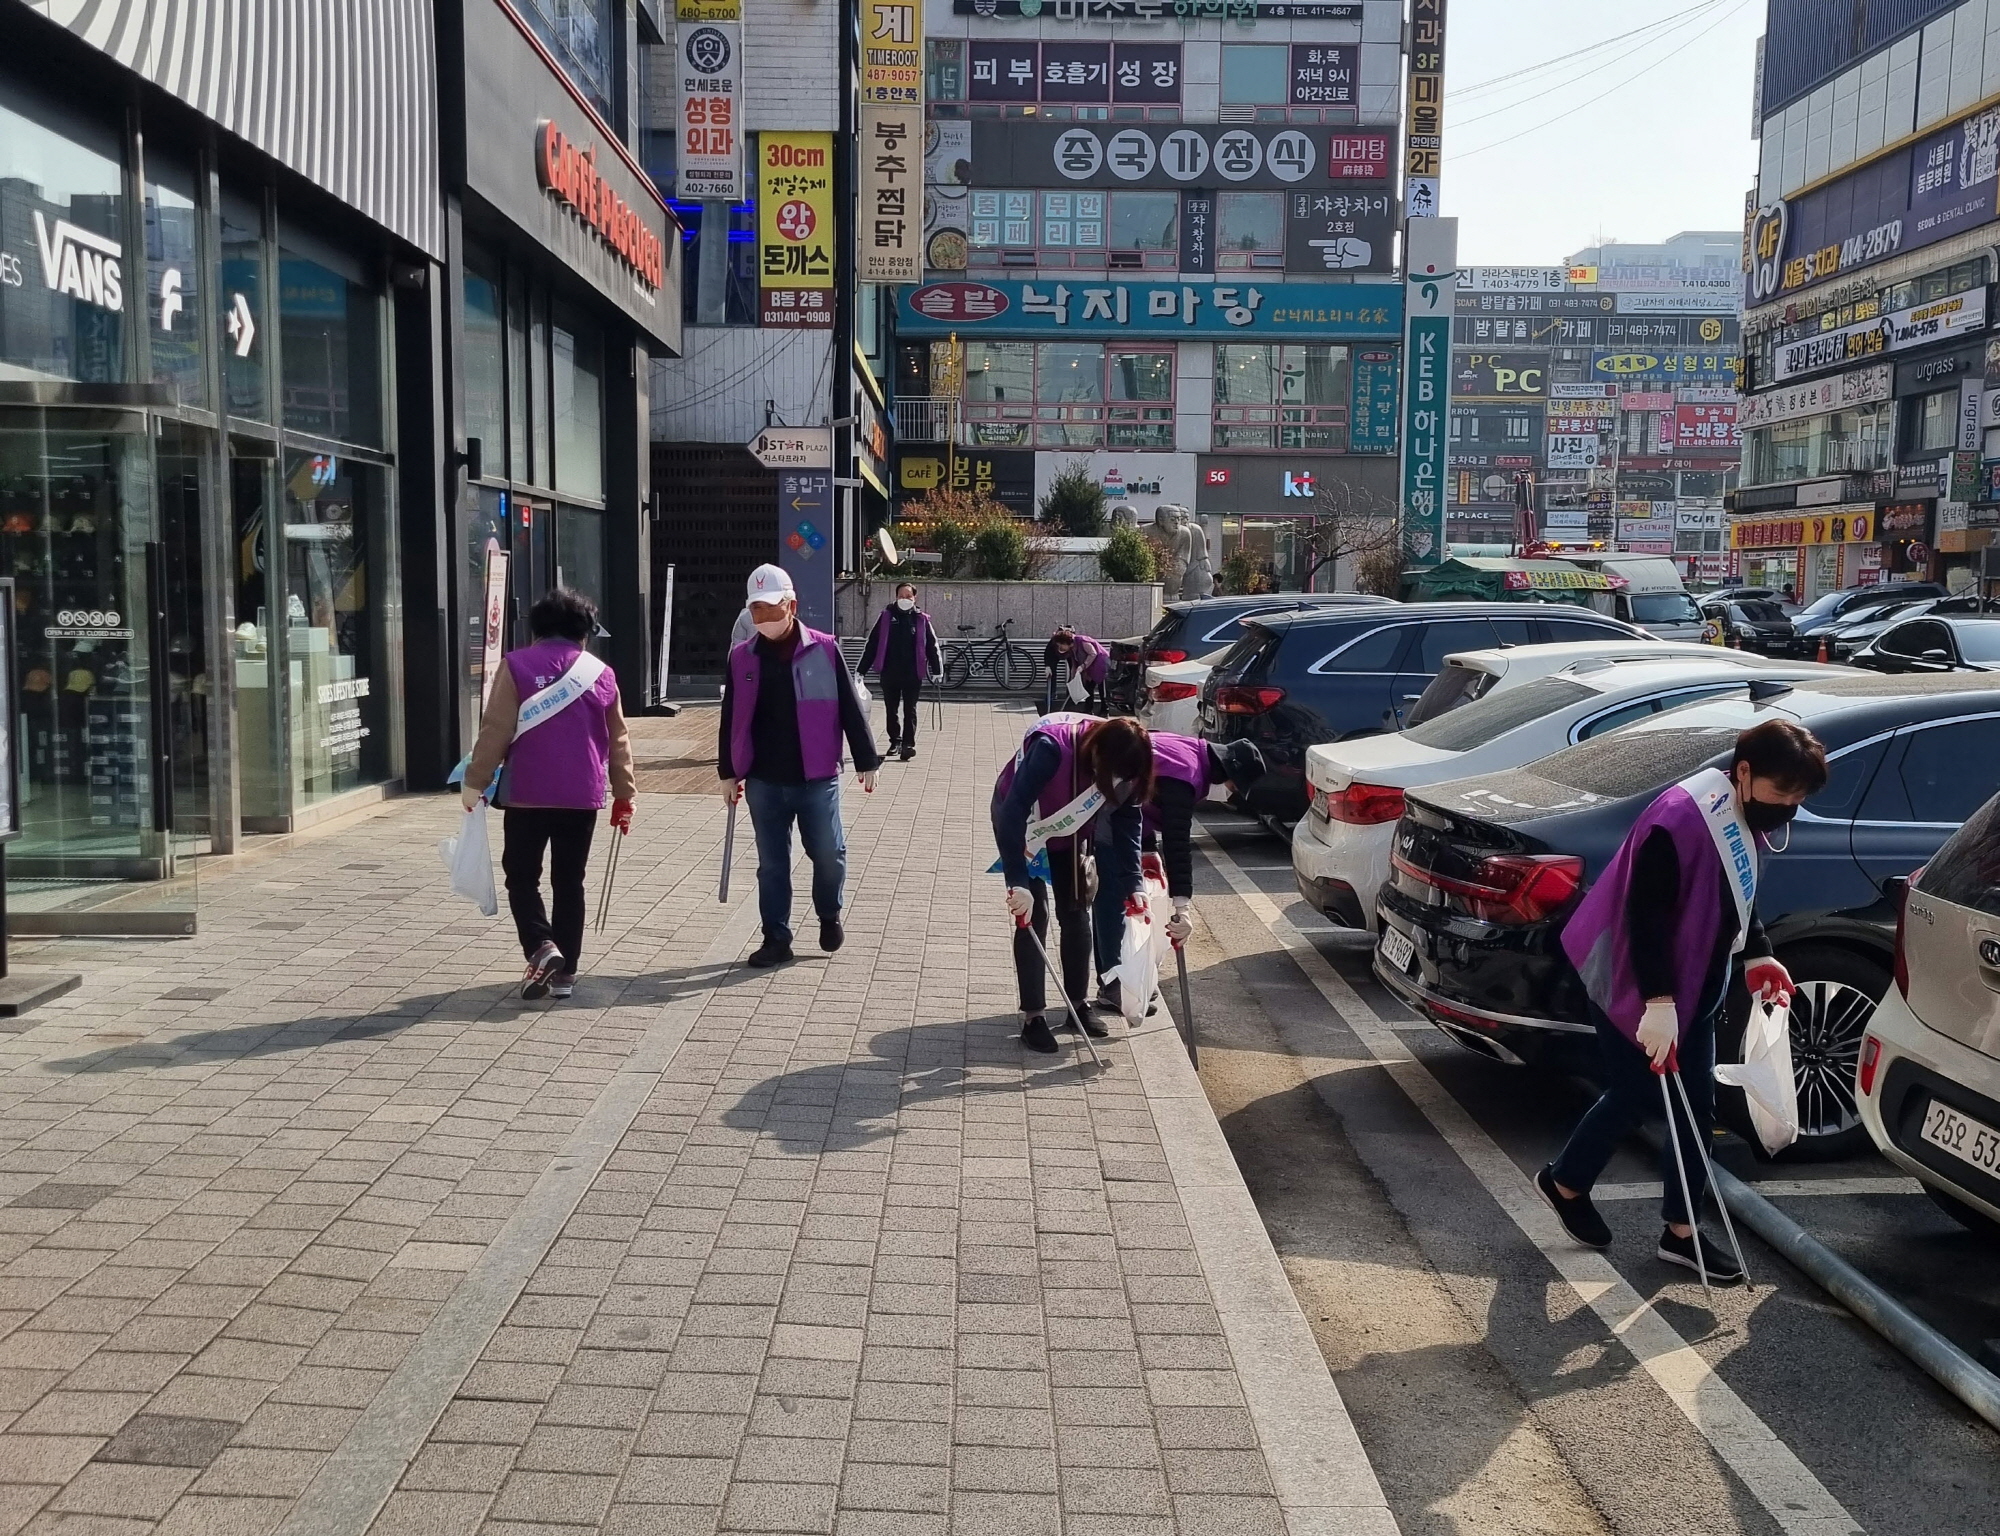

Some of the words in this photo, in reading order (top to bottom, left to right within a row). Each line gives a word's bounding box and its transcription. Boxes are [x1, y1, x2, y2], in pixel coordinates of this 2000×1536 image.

[680, 7, 735, 19] 480-6700
[1269, 7, 1285, 16] 4층
[1291, 7, 1308, 16] TEL
[1311, 7, 1352, 16] 411-4647
[871, 4, 914, 43] 계
[867, 48, 918, 67] TIMEROOT
[1308, 50, 1341, 65] 화,목
[1416, 53, 1440, 69] 3F
[1044, 61, 1107, 85] 호흡기
[1117, 60, 1177, 87] 성장
[1297, 68, 1323, 83] 저녁
[1328, 68, 1350, 83] 9시
[684, 78, 733, 93] 연세로운
[866, 86, 918, 101] 1층안쪽
[1296, 87, 1350, 101] 야간진료
[684, 97, 732, 125] 성형
[1414, 77, 1438, 134] 미올
[686, 128, 734, 155] 외과
[1332, 139, 1386, 161] 마라탕
[1411, 137, 1440, 148] 한의원
[767, 144, 825, 167] 30cm
[1062, 137, 1306, 174] 중국가정식
[1410, 151, 1438, 174] 2F
[1927, 140, 1954, 168] 서울대
[685, 183, 734, 194] 402-7660
[768, 175, 826, 196] 옛날수제
[875, 122, 907, 249] 봉추찜닭
[1917, 162, 1953, 194] 동문병원
[780, 204, 811, 239] 왕
[1917, 216, 1935, 231] SEOUL
[1942, 206, 1964, 223] DENTAL
[1965, 197, 1986, 214] CLINIC
[1327, 221, 1355, 234] 2호점
[1758, 218, 1779, 260] 4F
[34, 209, 124, 313] VANS
[764, 244, 830, 276] 돈까스
[868, 255, 886, 267] 안산
[888, 255, 913, 267] 중앙점
[1781, 244, 1841, 290] 서울S치과
[1839, 219, 1904, 271] 414-2879
[1481, 280, 1540, 289] T.403-4779
[1482, 268, 1539, 279] 라라스튜디오
[1543, 269, 1562, 288] 1층
[1681, 280, 1731, 288] T.410.4300
[771, 291, 796, 308] B동
[800, 291, 824, 308] 2층
[920, 288, 999, 314] 솔밭
[1022, 284, 1263, 326] 낙지마당
[1481, 296, 1542, 311] 방탈출카페
[764, 311, 831, 323] 031)410-0908
[1477, 319, 1527, 338] 방탈출
[1560, 320, 1591, 338] 카페
[1702, 324, 1720, 341] 6F
[1418, 332, 1436, 402] KEB
[1917, 357, 1954, 381] urgrass
[1494, 368, 1542, 393] PC
[1557, 419, 1595, 432] 부동산
[1964, 394, 1978, 449] urgrass
[805, 444, 829, 452] PLAZA
[1551, 437, 1583, 454] 사진
[763, 454, 807, 464] 지스타프라자
[1411, 409, 1439, 518] 하나은행
[784, 476, 828, 494] 출입구
[1209, 470, 1226, 483] 5G
[1284, 470, 1316, 497] kt
[1457, 511, 1489, 519] PLACE
[1638, 523, 1671, 532] 스티커사진
[1972, 1130, 2000, 1174] 53
